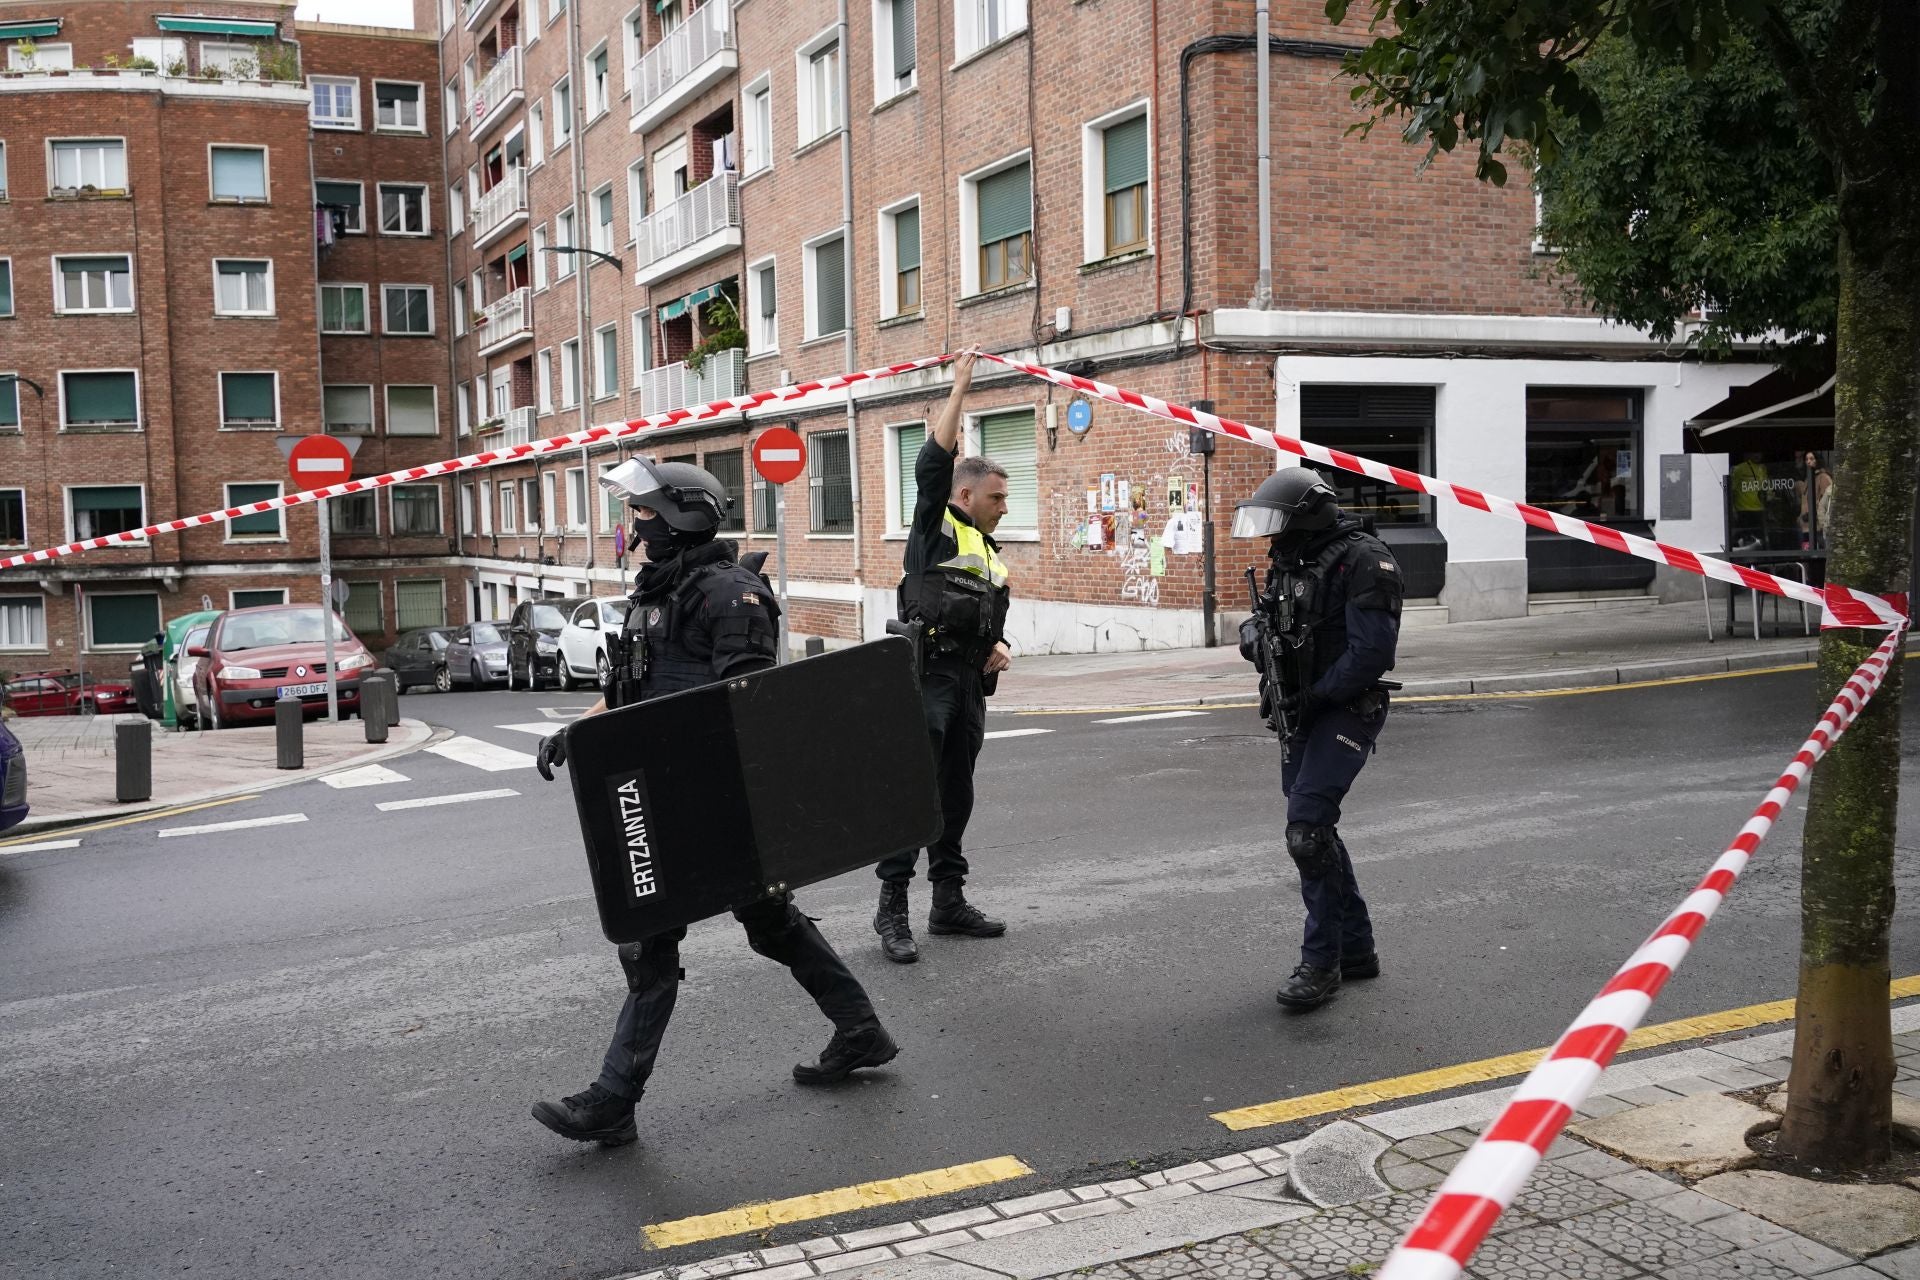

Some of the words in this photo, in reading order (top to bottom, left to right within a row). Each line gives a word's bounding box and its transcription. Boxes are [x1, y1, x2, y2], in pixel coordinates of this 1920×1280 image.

[1742, 481, 1760, 492] BAR
[1761, 478, 1795, 491] CURRO
[954, 577, 978, 589] POLIZIA
[732, 599, 738, 607] S
[285, 686, 308, 696] 2660
[617, 777, 657, 898] ERTZAINTZA
